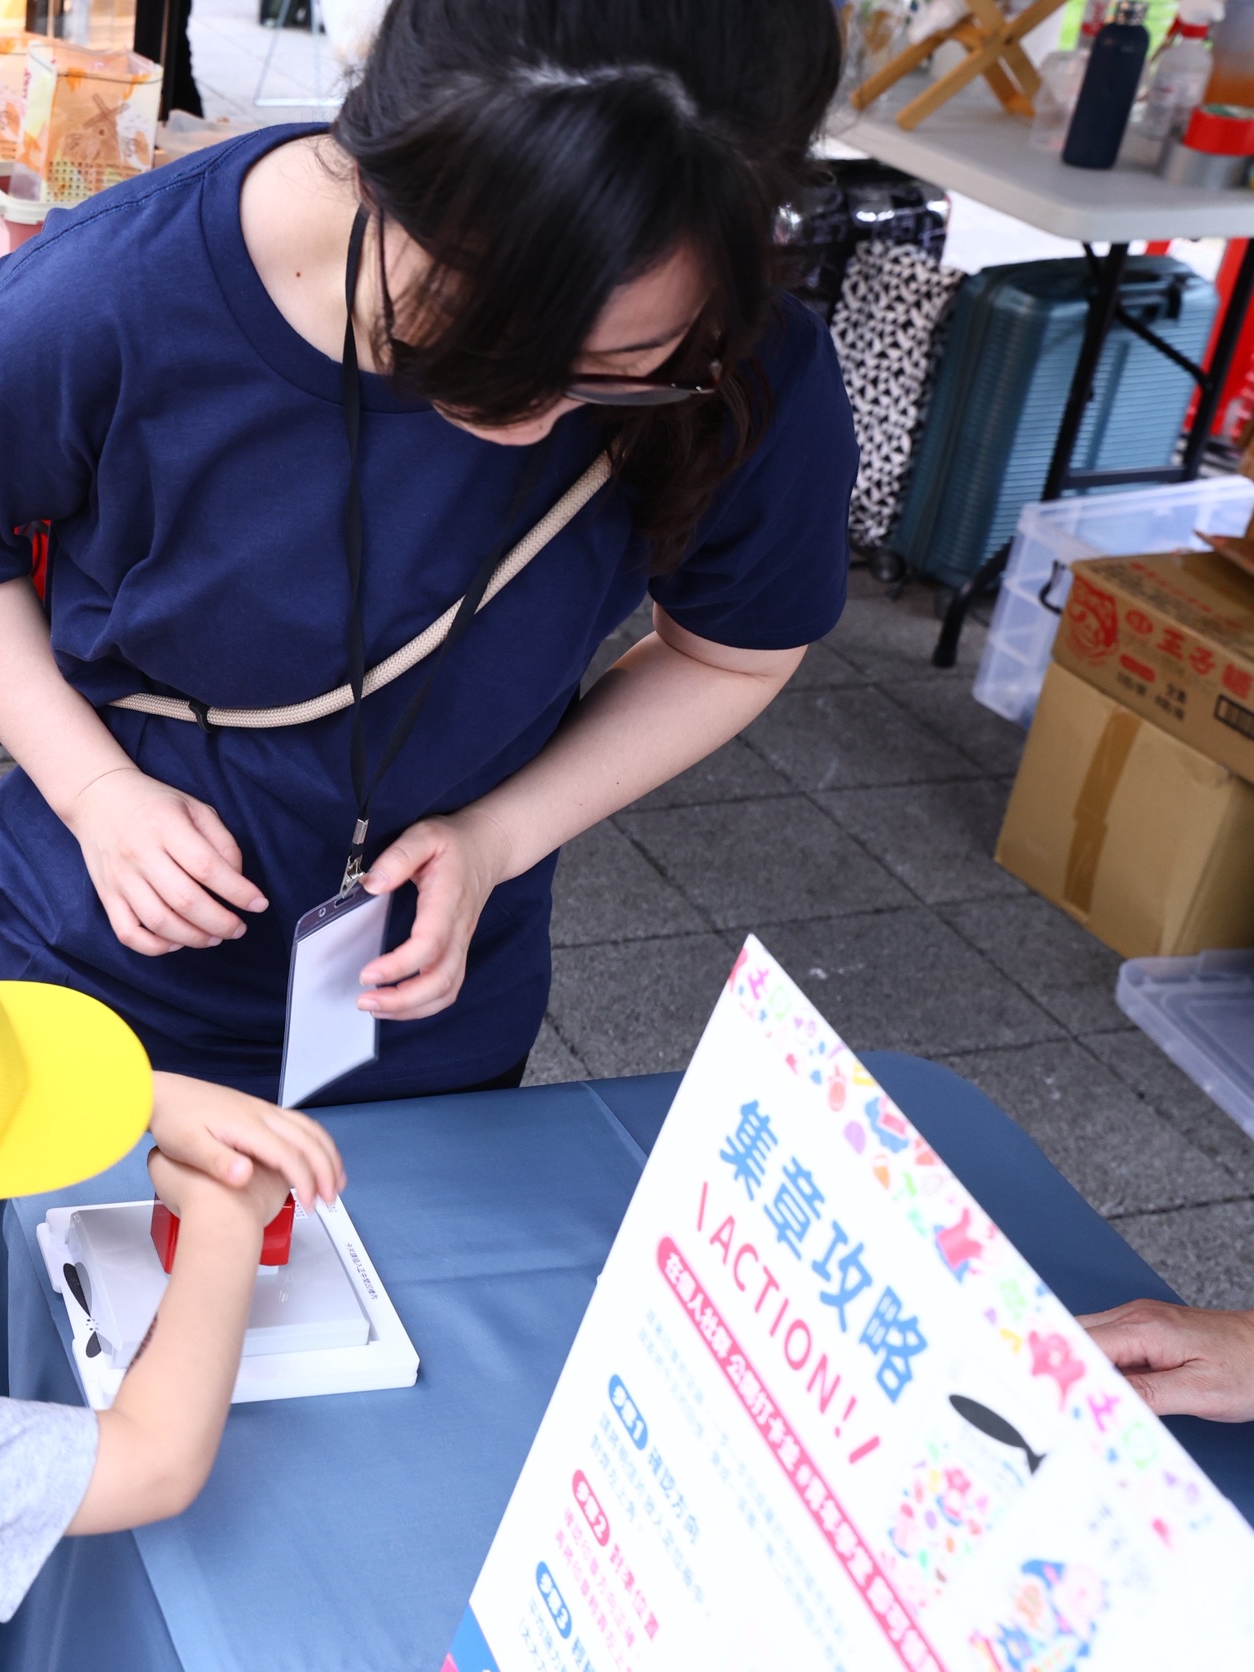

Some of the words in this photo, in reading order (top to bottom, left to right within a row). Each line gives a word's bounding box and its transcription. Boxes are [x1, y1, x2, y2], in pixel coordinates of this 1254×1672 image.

[719, 1099, 928, 1404] 集章攻略
[648, 1445, 701, 1545] 確認方向
